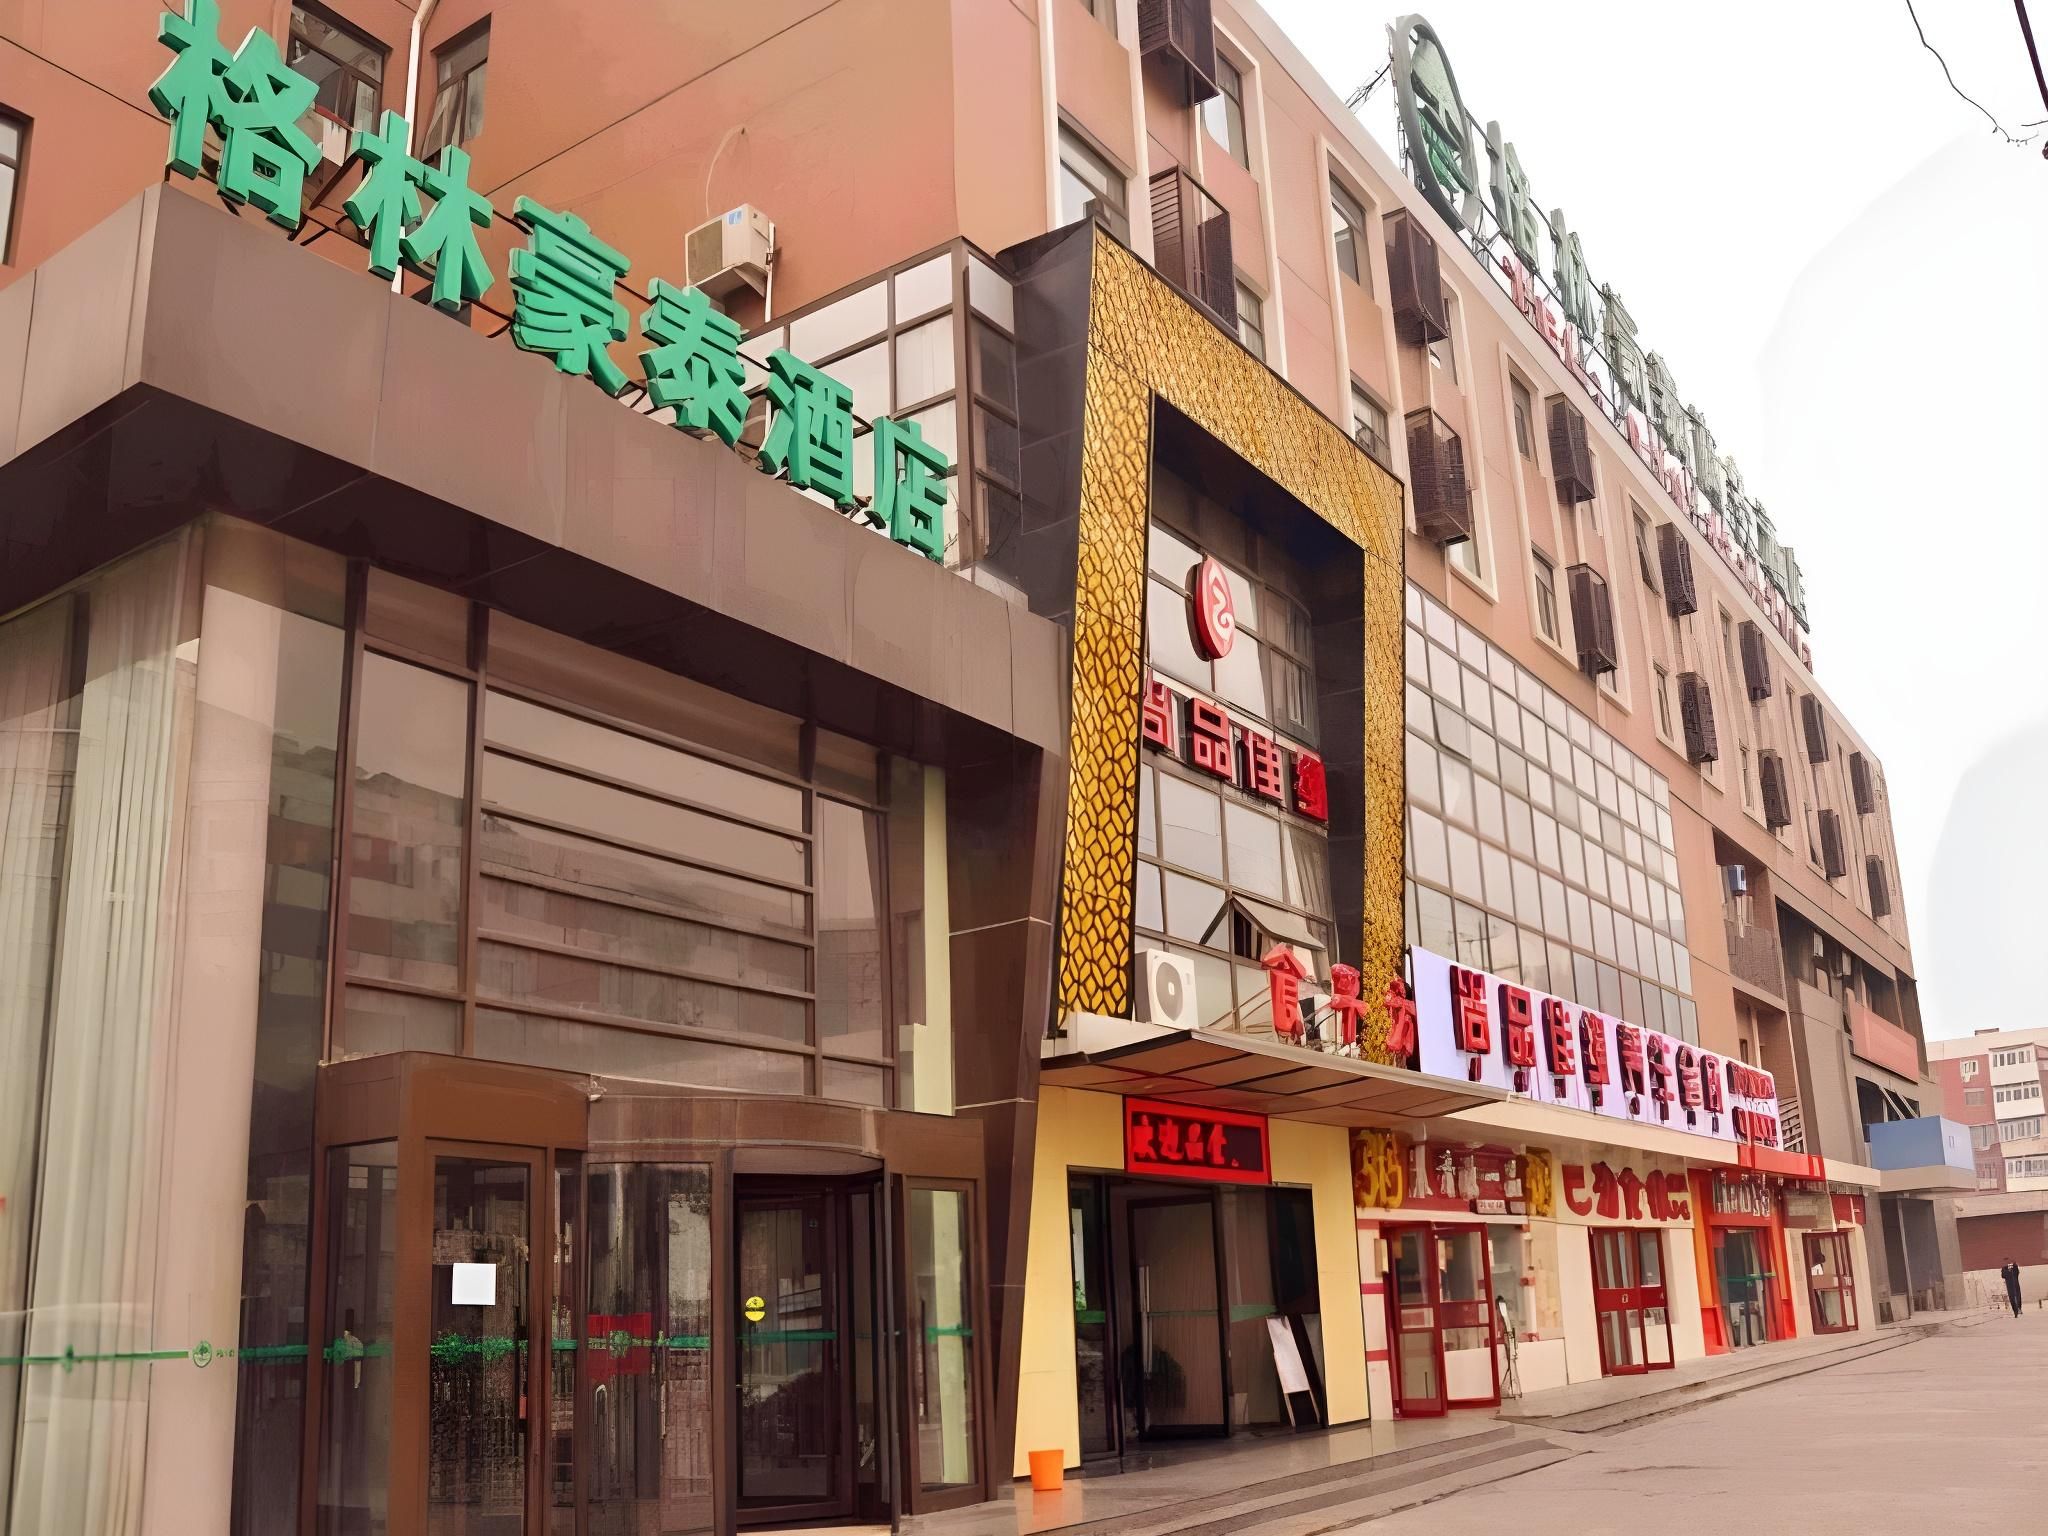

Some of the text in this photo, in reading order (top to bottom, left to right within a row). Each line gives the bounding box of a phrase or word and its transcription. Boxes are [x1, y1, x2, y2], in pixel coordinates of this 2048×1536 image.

[148, 0, 950, 562] 格林豪泰酒店
[1142, 667, 1329, 821] 尚品佳
